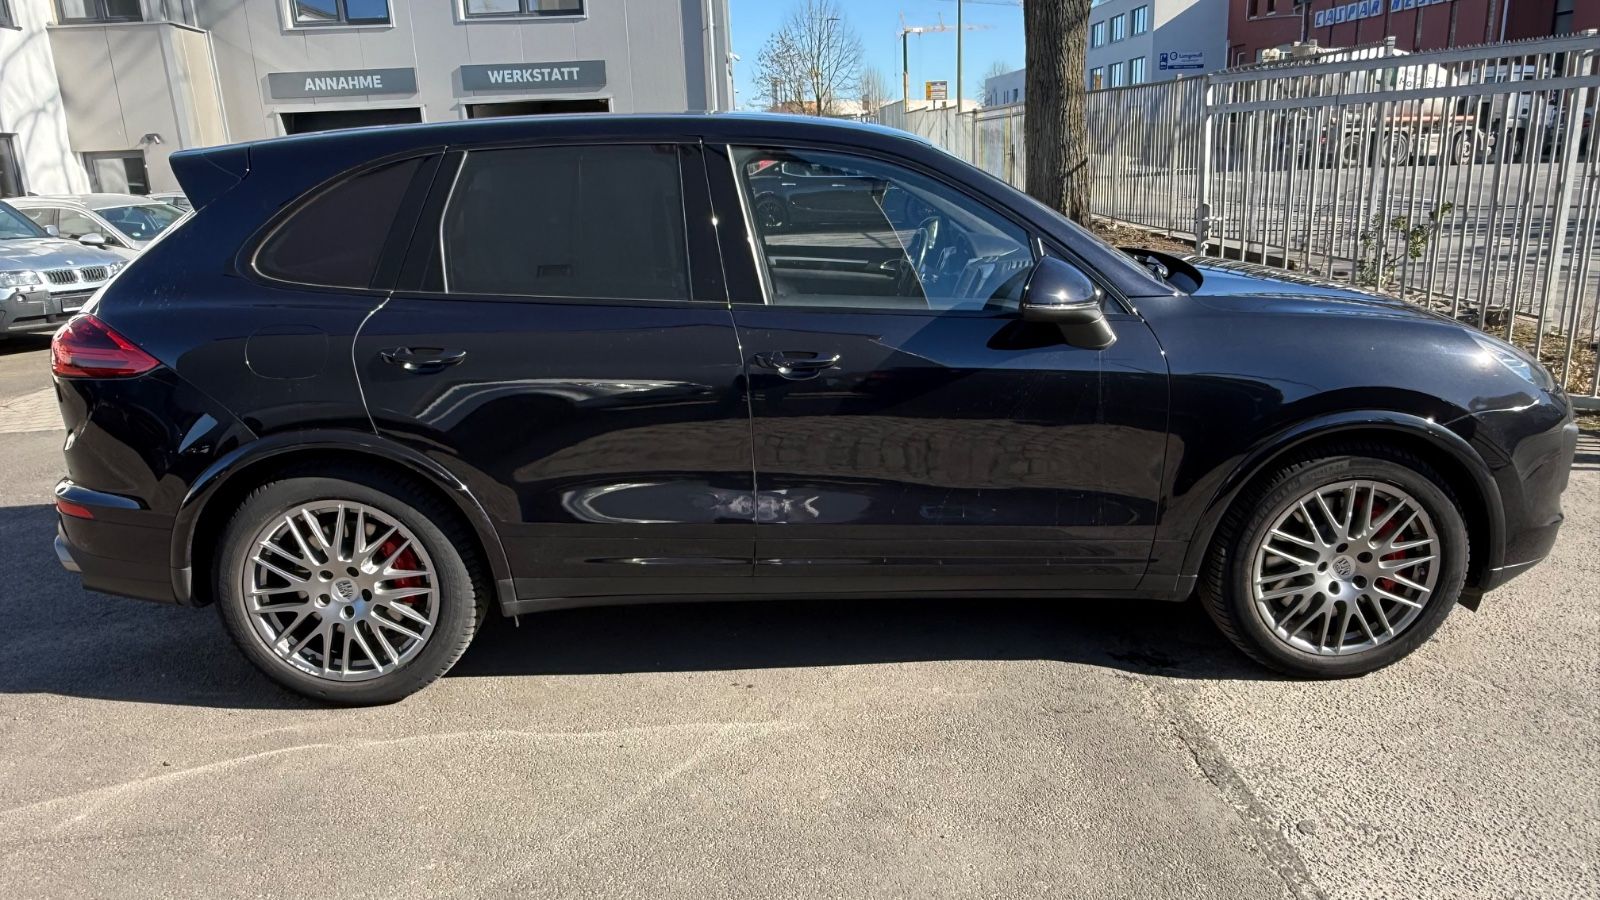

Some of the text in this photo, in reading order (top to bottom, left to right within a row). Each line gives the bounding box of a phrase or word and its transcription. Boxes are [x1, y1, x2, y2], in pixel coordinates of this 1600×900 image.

[1315, 0, 1380, 26] CASPAR
[304, 75, 383, 91] ANNAHME
[487, 67, 580, 84] WERKSTATT
